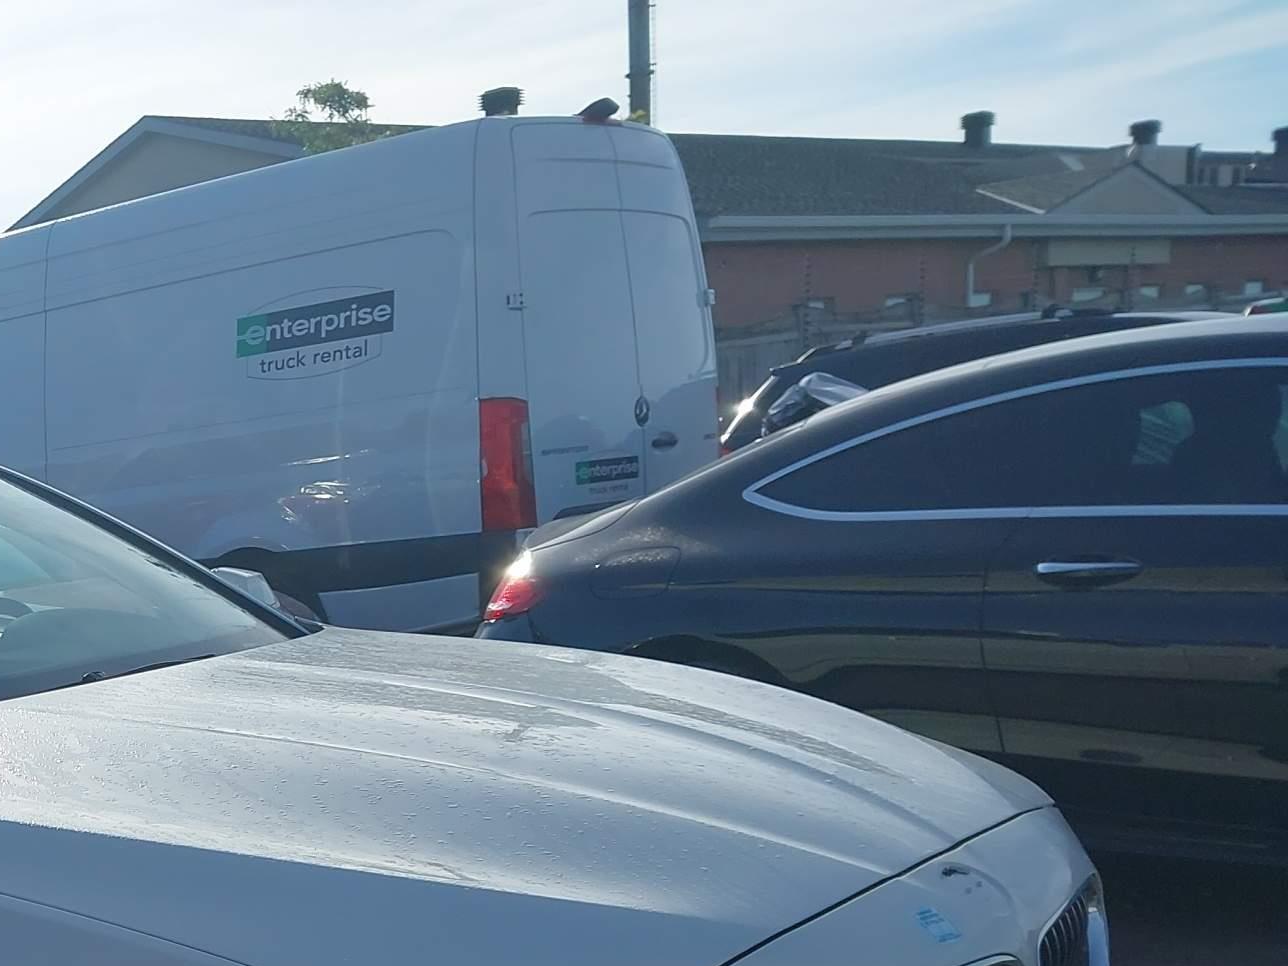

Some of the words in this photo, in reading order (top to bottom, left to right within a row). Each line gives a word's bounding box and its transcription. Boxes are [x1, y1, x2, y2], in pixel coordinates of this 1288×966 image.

[244, 303, 392, 345] enterprise
[259, 350, 306, 374] truck
[312, 339, 369, 365] rental
[577, 460, 639, 480] enterprise
